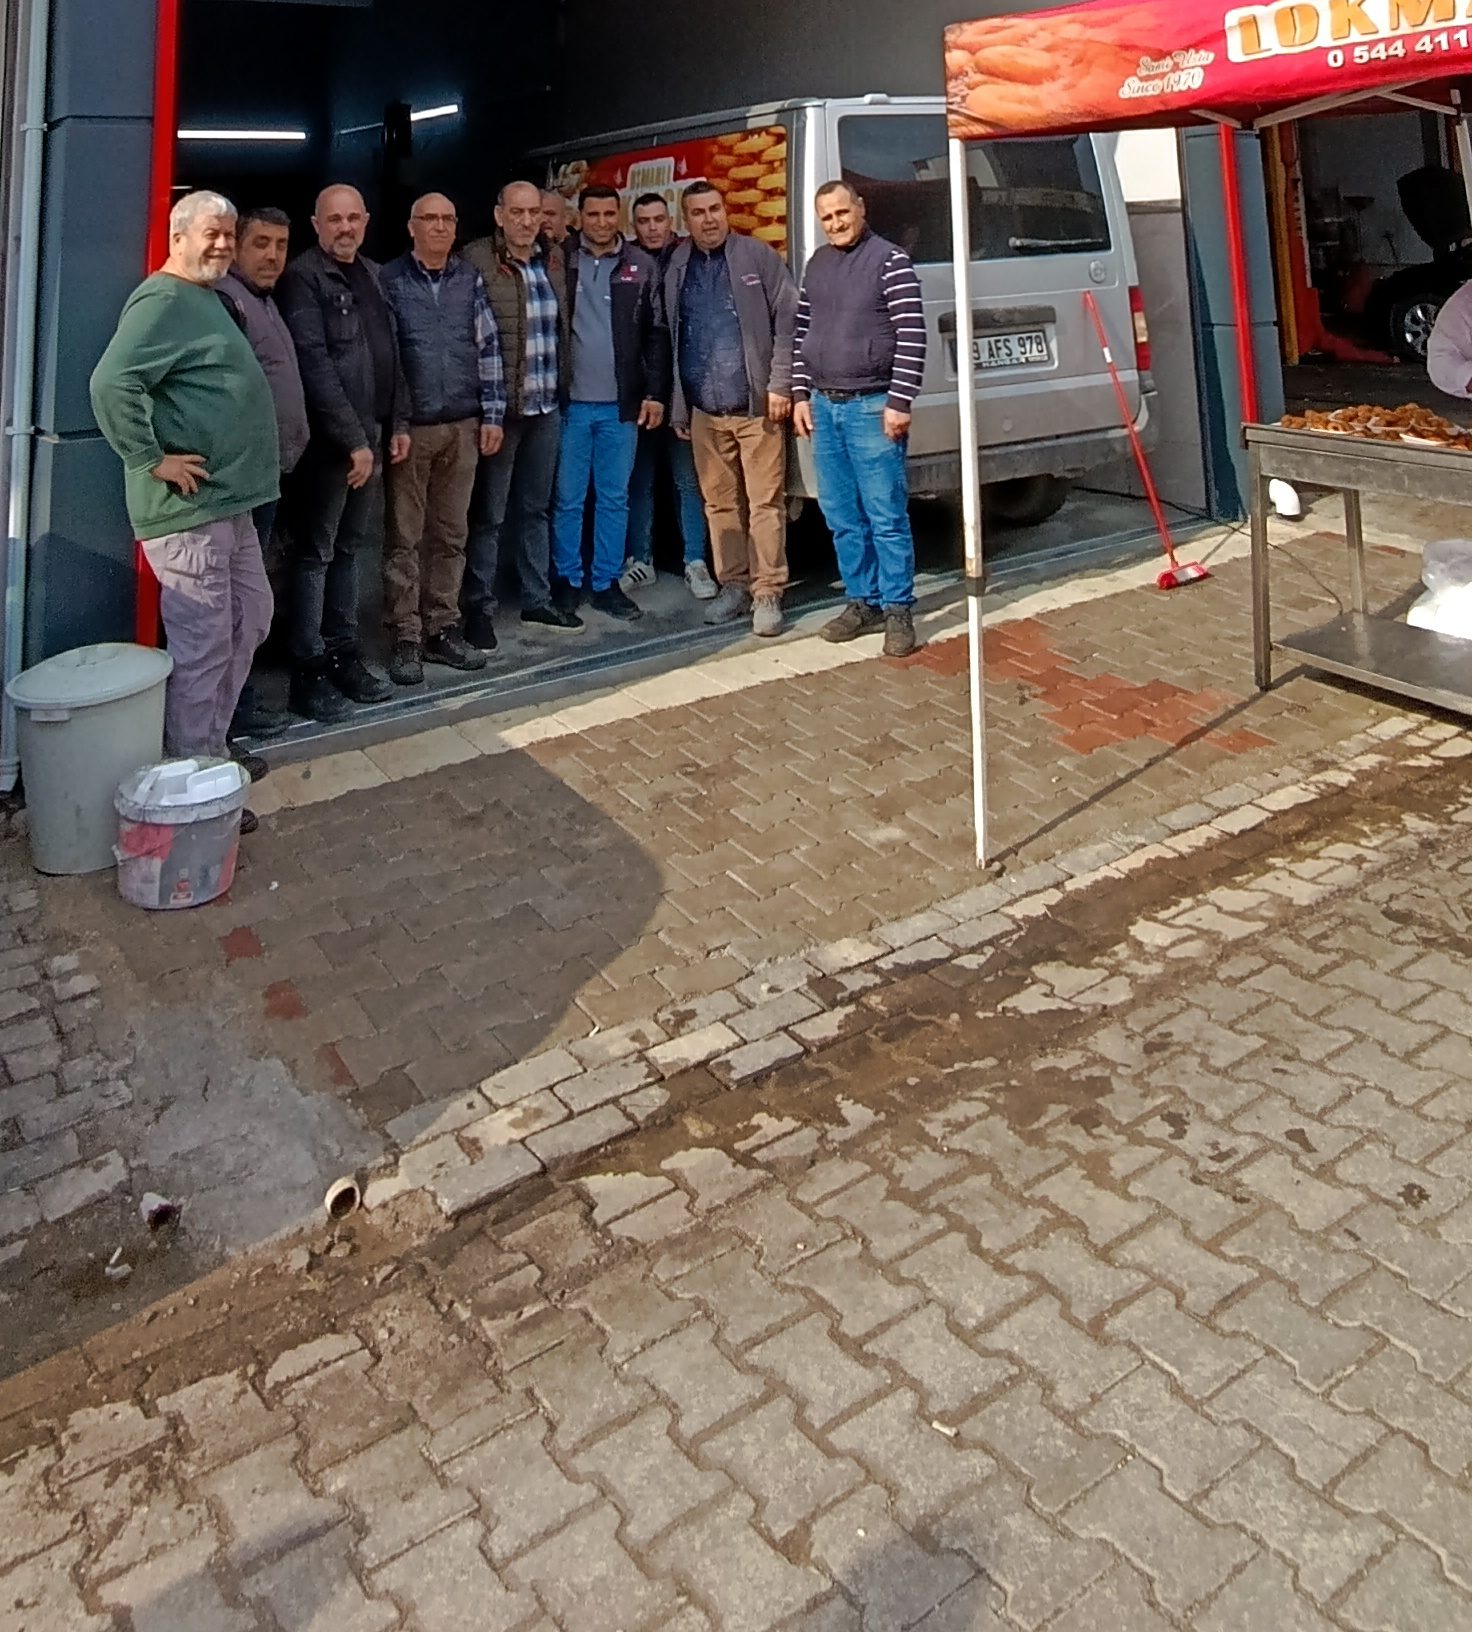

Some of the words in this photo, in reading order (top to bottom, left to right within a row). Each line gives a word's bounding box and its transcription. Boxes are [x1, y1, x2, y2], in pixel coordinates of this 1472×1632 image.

[1327, 49, 1345, 68] 0
[1352, 38, 1407, 65] 544
[1414, 29, 1470, 54] 411
[1119, 76, 1163, 98] Since
[1163, 67, 1204, 93] 1970
[987, 337, 1013, 360] AFS
[1017, 334, 1044, 355] 978
